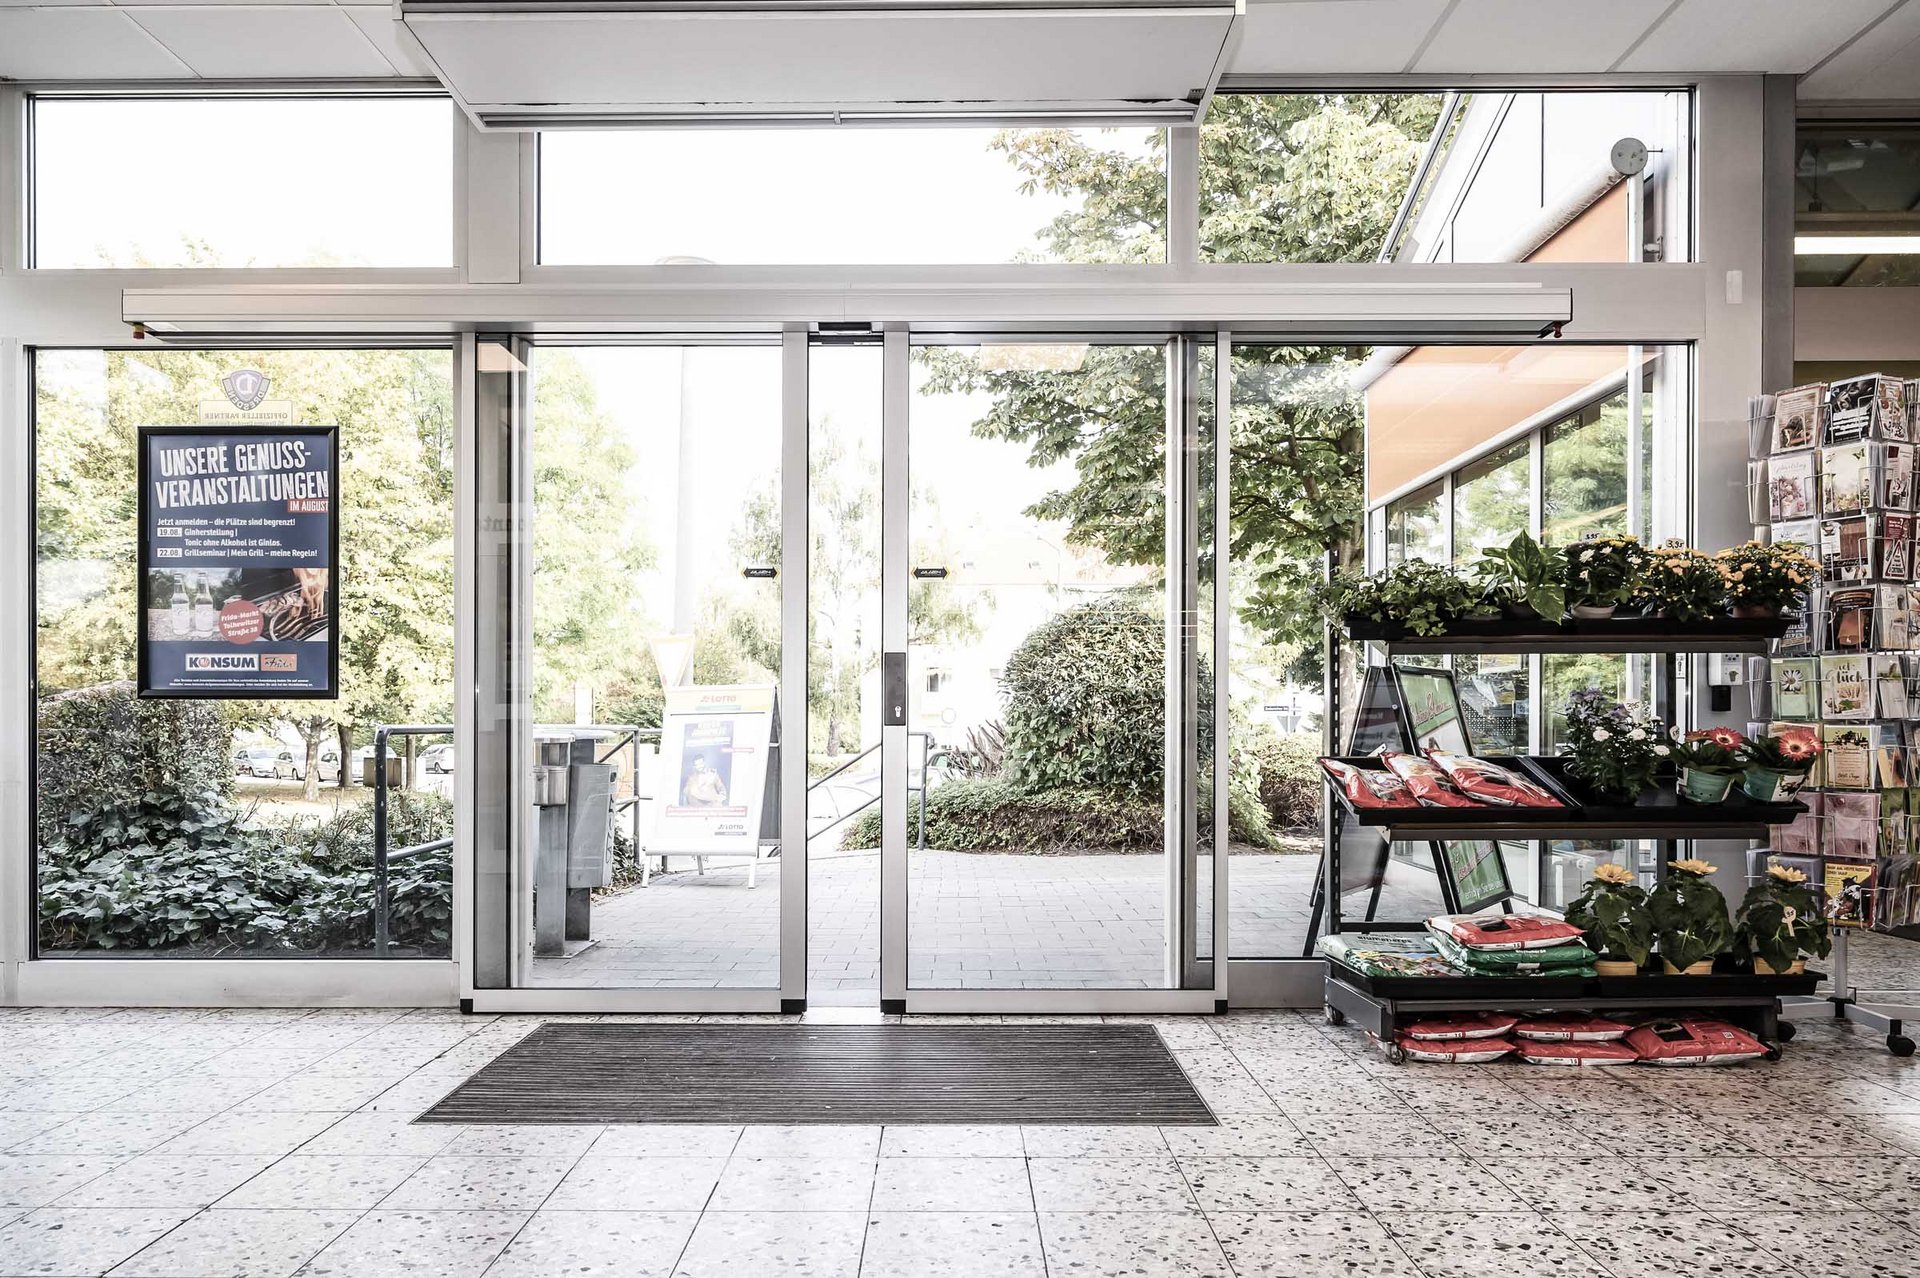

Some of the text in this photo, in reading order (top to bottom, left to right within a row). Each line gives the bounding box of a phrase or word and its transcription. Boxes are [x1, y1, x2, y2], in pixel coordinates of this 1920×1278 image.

[160, 441, 311, 477] UNSERE GENUSS-
[155, 471, 329, 509] VERANSTALTUNGEN
[290, 500, 329, 512] IM AUGUST
[157, 518, 174, 526] Jetzt
[175, 518, 209, 526] anmelden
[214, 518, 224, 526] die
[226, 518, 247, 526] Plätze
[248, 518, 263, 526] sind
[263, 518, 296, 528] begrenzt!
[184, 528, 234, 538] Ginherstellung
[184, 549, 226, 557] Grillseminar
[230, 549, 248, 557] Mein
[248, 549, 264, 557] Grill
[270, 549, 292, 557] meine
[292, 549, 318, 559] Regeln!
[189, 657, 256, 668] KONSUM
